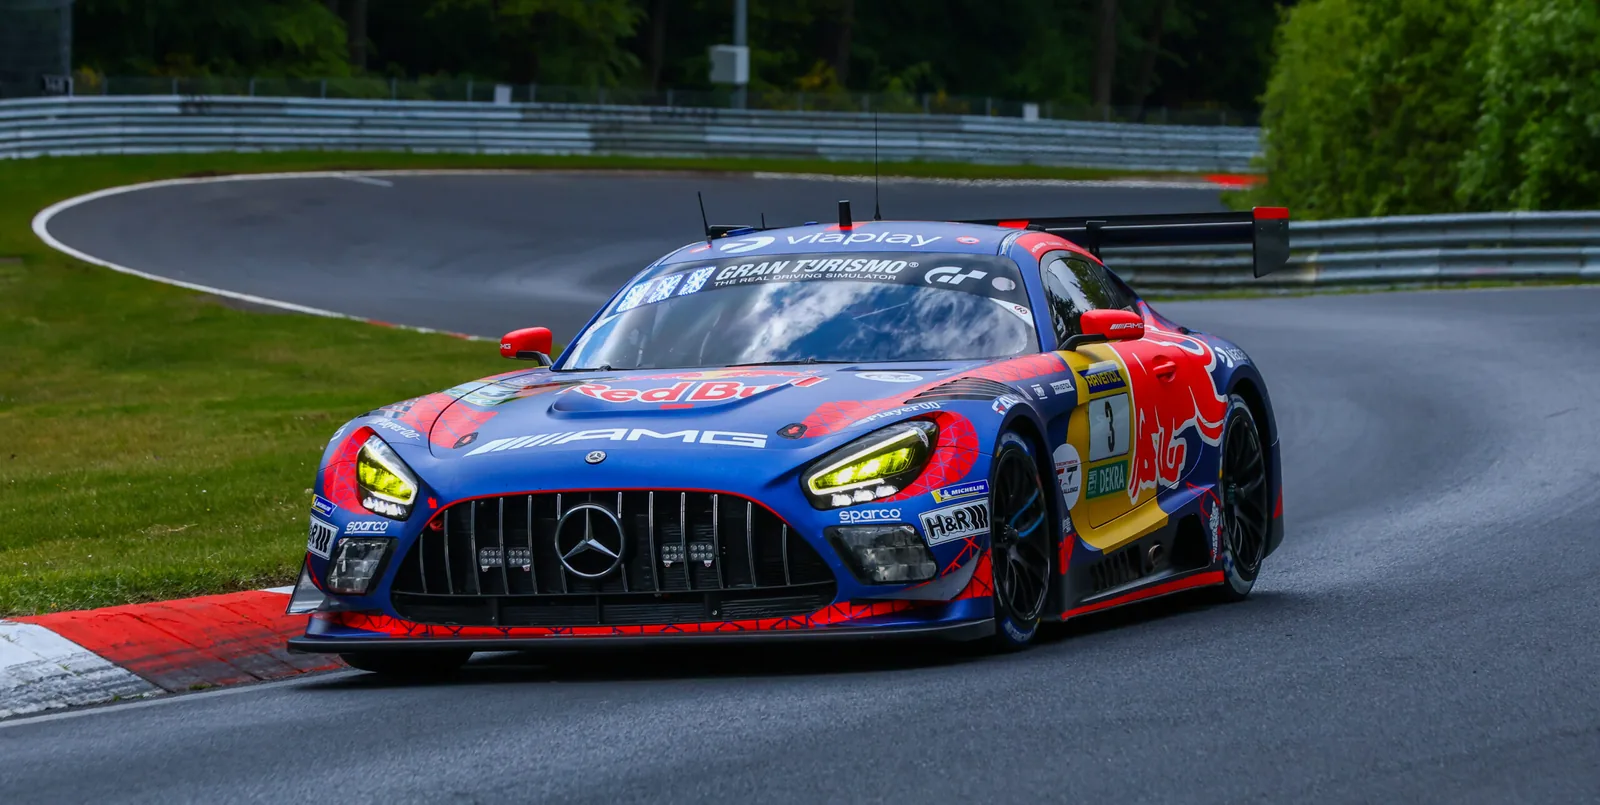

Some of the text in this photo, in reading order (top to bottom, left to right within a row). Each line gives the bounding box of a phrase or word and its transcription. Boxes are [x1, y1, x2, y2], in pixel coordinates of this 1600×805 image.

[787, 231, 943, 247] viaplay
[713, 272, 897, 287] THE REAL DRIVING SIMULATOR
[715, 260, 791, 281] GRAN
[1085, 371, 1121, 387] RAVENOL
[559, 381, 690, 402] Red
[1104, 401, 1116, 453] 3
[556, 428, 768, 449] AMG
[1099, 463, 1125, 493] DEKRA
[951, 484, 985, 496] MICHELIN
[839, 508, 901, 524] sparco
[925, 509, 971, 539] H&R
[345, 521, 389, 534] sparco
